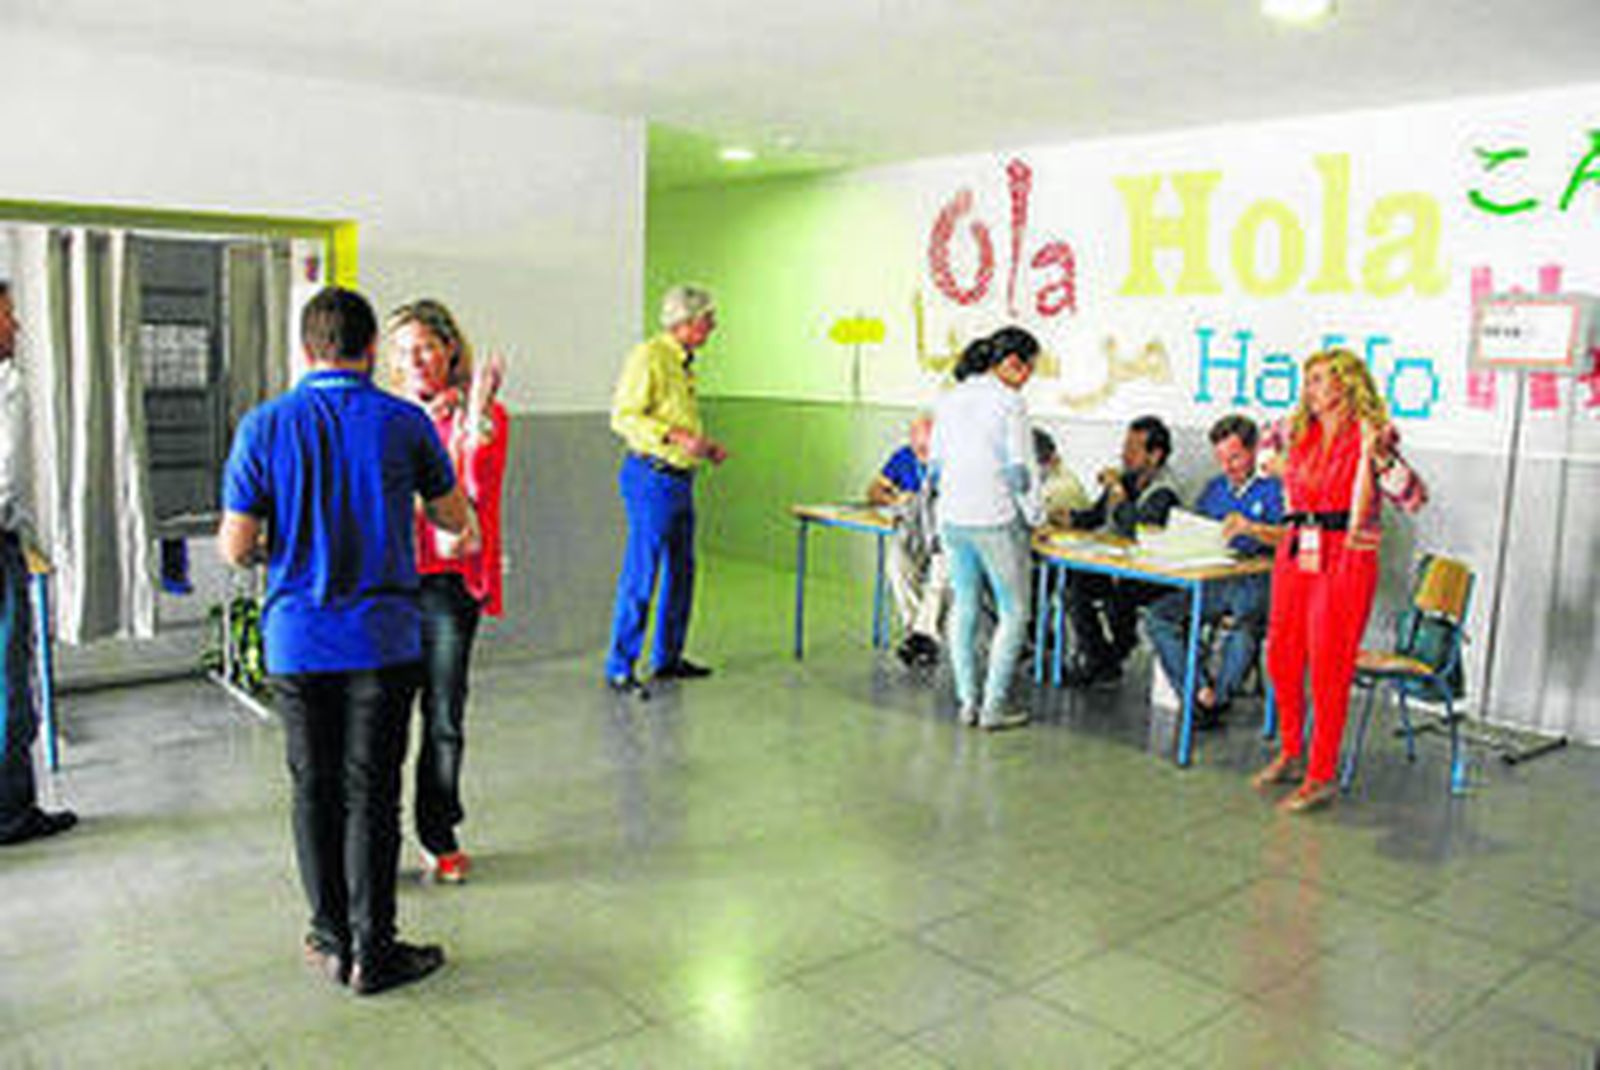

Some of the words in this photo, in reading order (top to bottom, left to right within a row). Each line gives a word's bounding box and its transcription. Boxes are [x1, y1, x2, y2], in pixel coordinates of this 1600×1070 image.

[1113, 152, 1450, 299] Hola
[914, 290, 1174, 410] مربا
[1194, 326, 1440, 418] Hao
